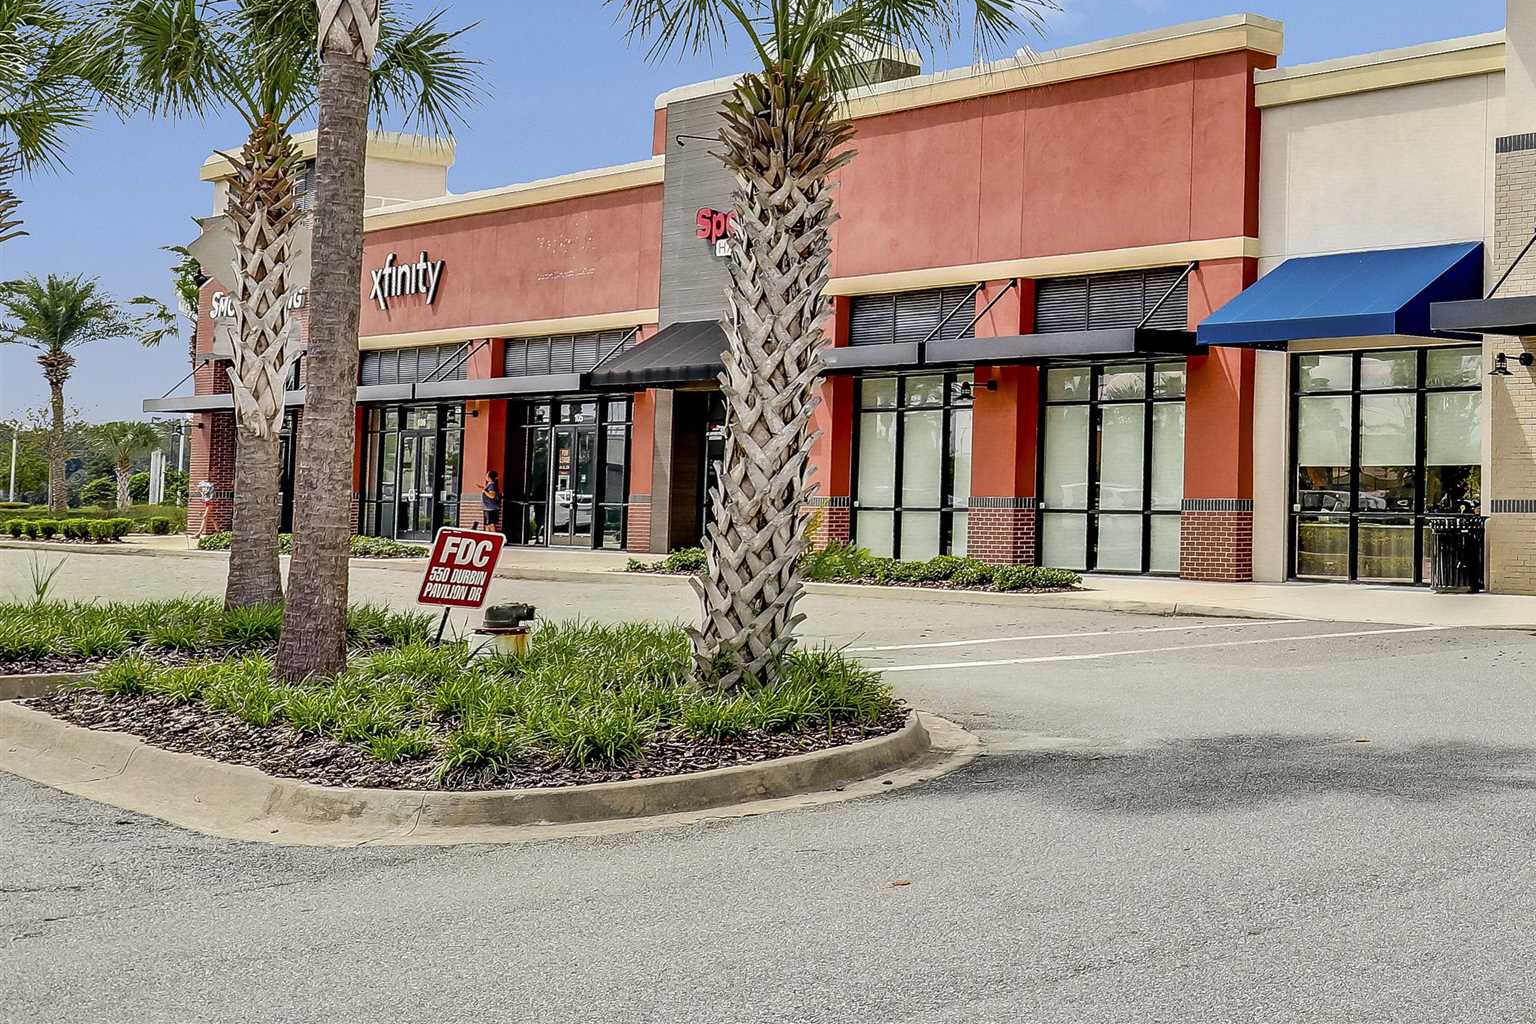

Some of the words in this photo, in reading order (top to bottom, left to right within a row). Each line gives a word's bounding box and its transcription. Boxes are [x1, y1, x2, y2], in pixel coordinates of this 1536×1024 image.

[369, 251, 444, 311] xfinity
[439, 536, 494, 568] FDC
[429, 566, 450, 583] 550
[450, 568, 487, 586] DURBIN
[423, 582, 468, 601] PAVILION
[467, 586, 483, 602] DR
